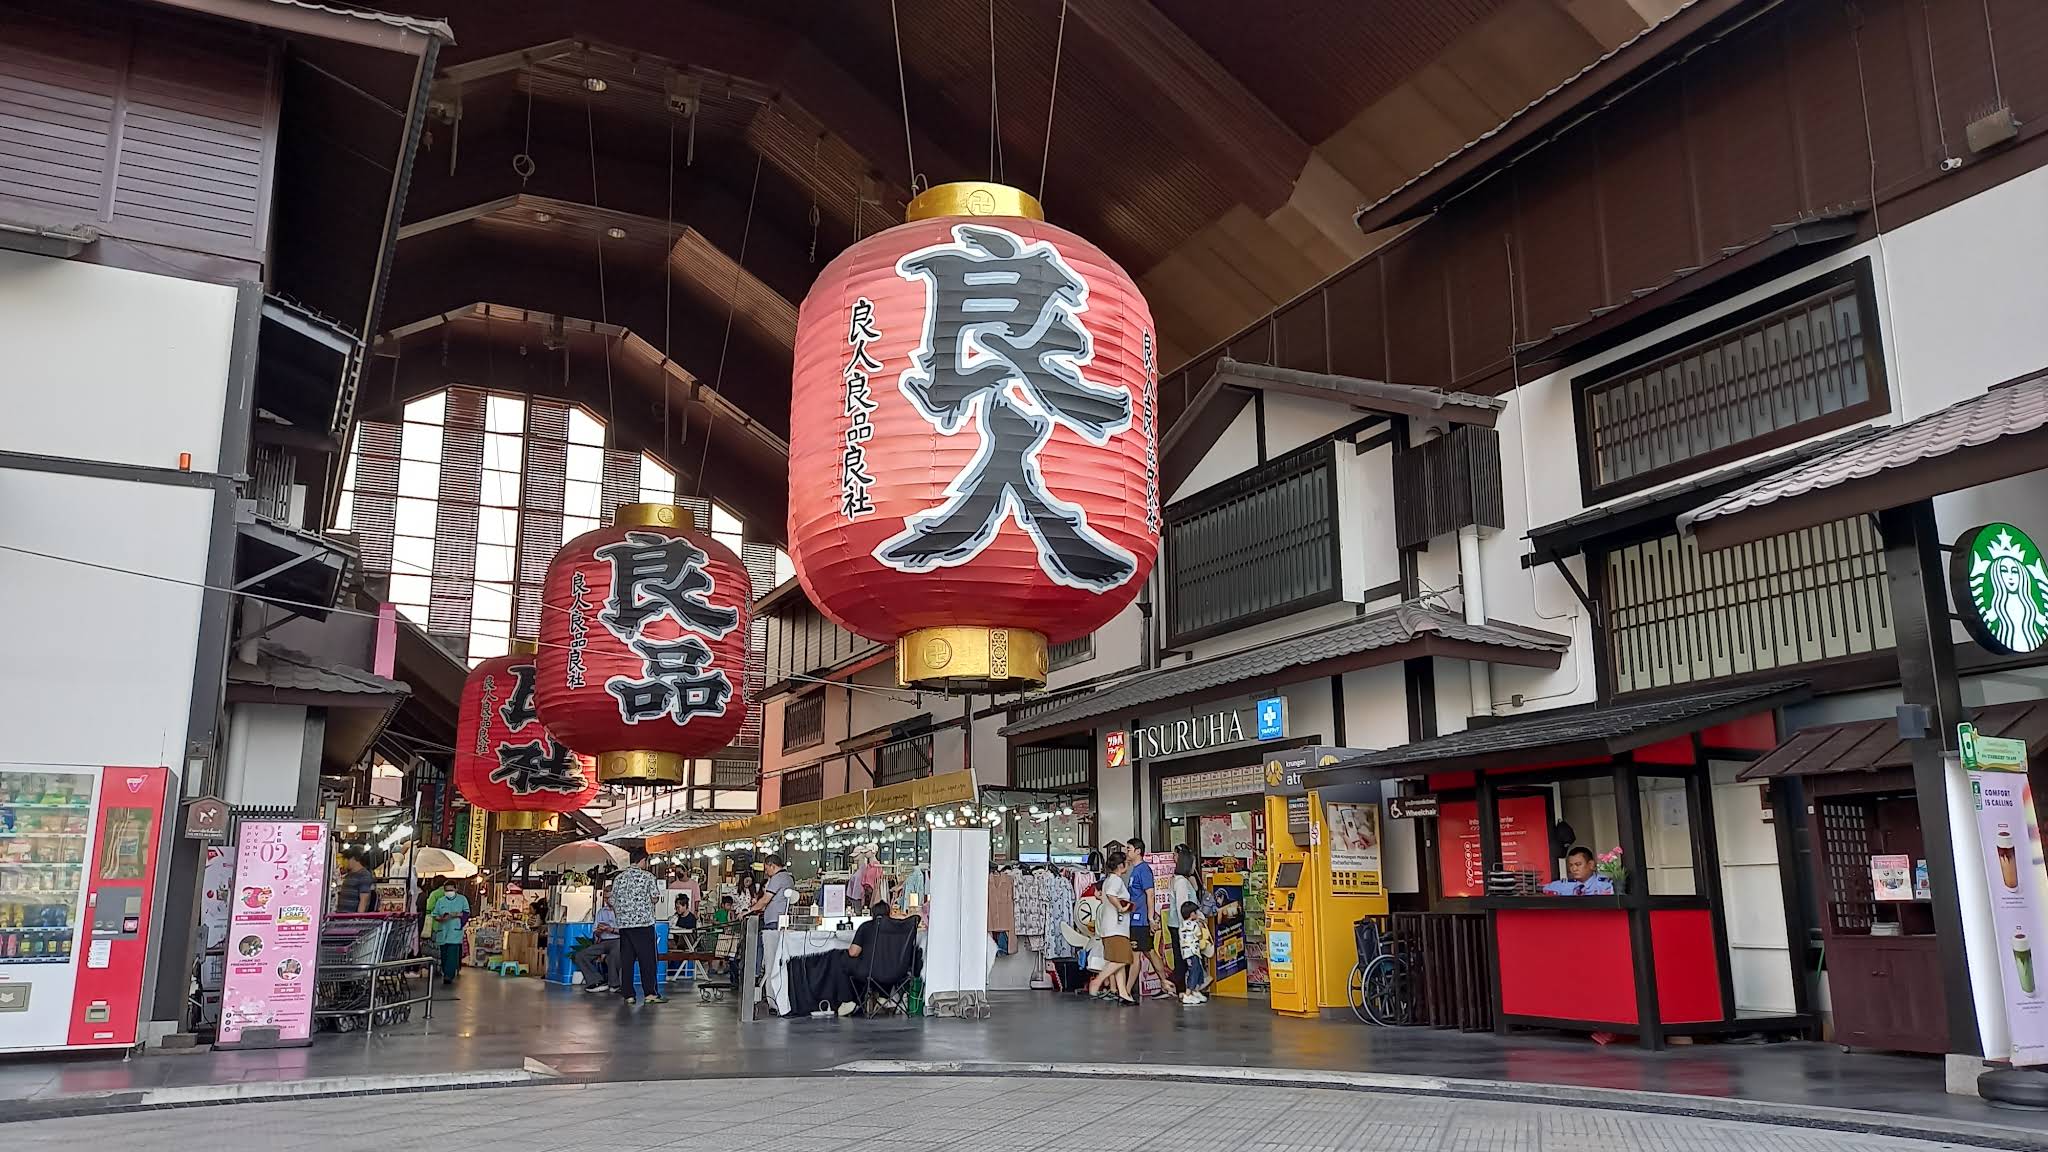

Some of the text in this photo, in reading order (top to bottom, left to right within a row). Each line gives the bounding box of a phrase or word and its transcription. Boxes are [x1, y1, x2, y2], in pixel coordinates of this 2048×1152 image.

[844, 298, 883, 519] 良人良品良社
[871, 224, 1138, 594] 良人
[568, 572, 593, 689] 良人良品良社
[595, 532, 740, 724] 良品
[1133, 709, 1245, 759] TSURUHA
[1405, 809, 1437, 817] Wheelchair
[1984, 789, 2011, 797] COMFORT
[1991, 799, 2014, 807] CALLING
